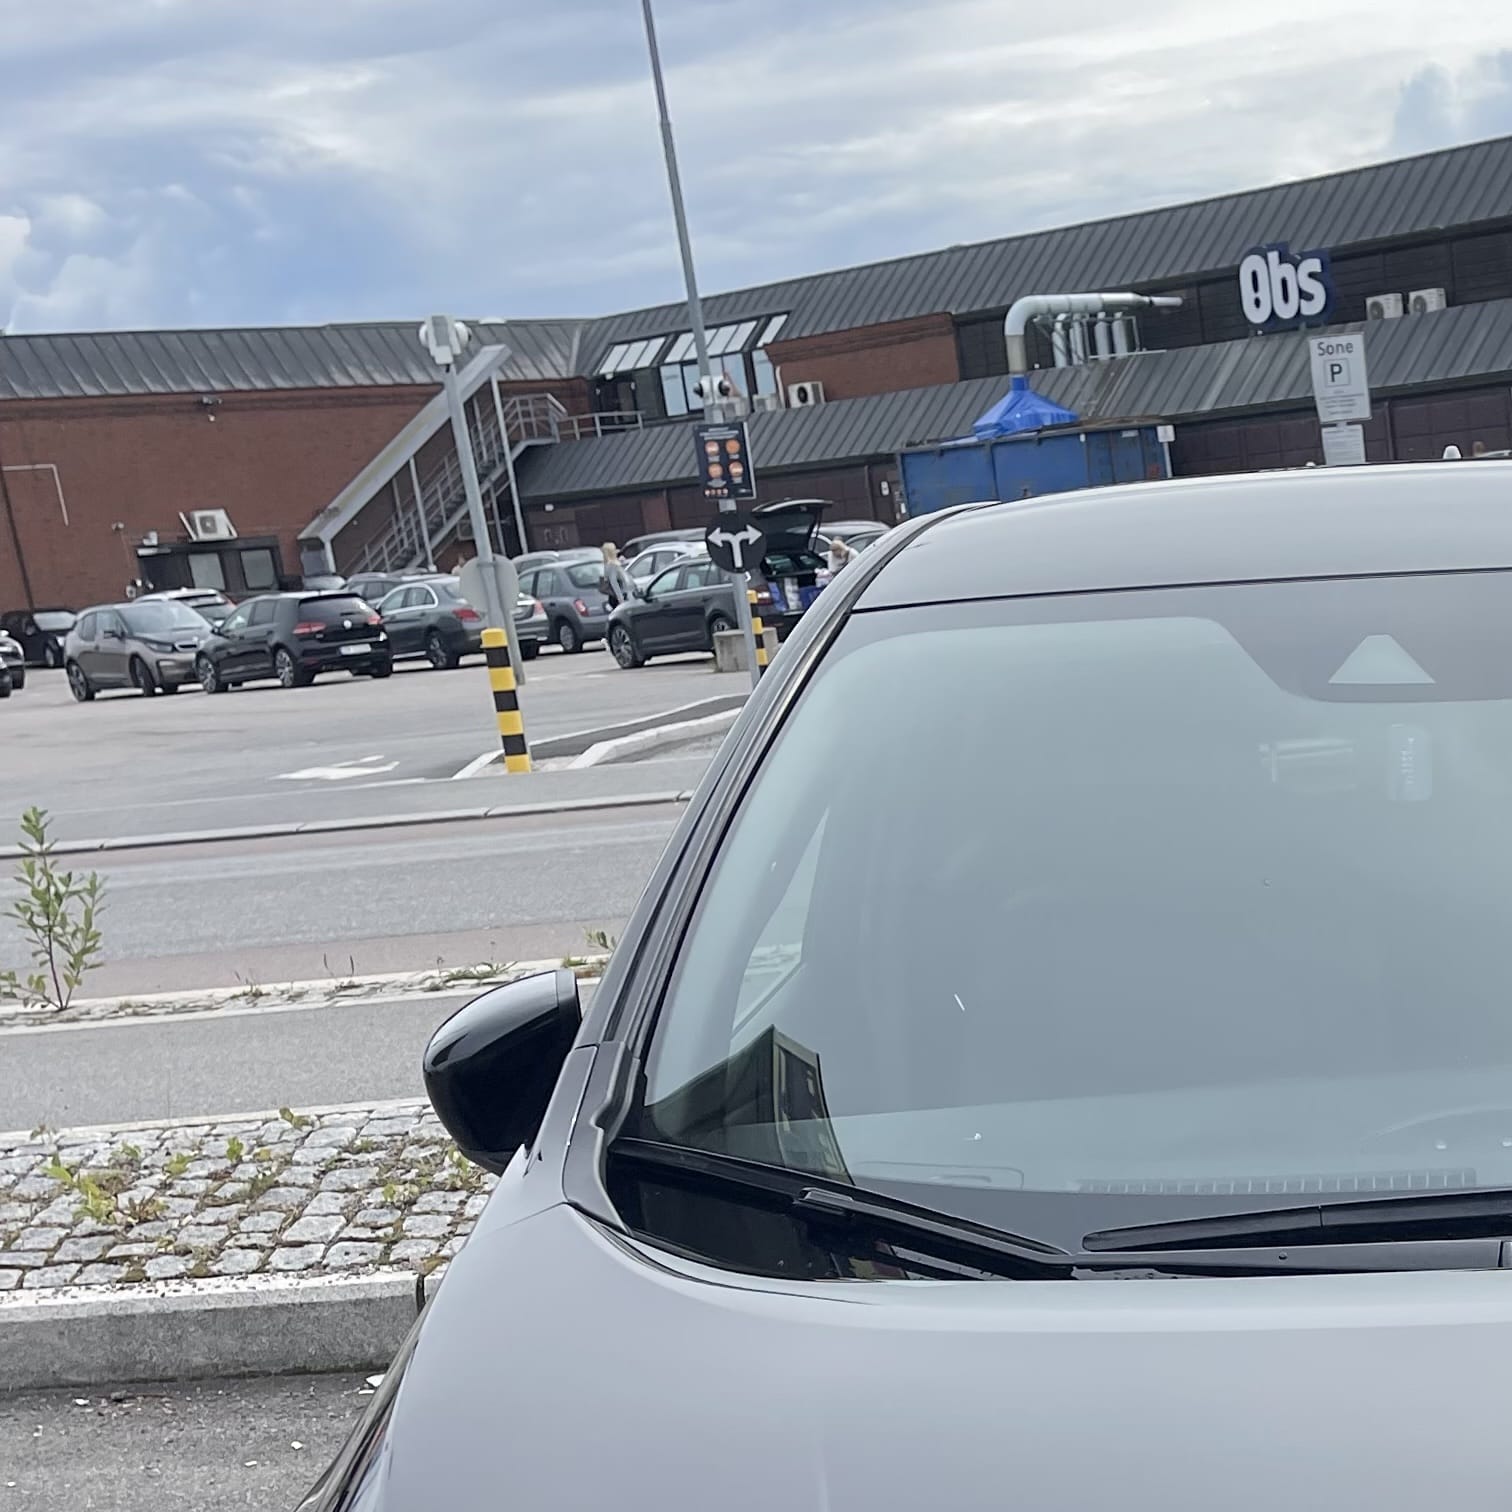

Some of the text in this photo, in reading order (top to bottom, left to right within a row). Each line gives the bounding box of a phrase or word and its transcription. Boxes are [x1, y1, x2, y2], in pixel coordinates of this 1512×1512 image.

[1239, 251, 1326, 324] Obs
[1317, 342, 1354, 356] Sone
[1330, 363, 1342, 382] P
